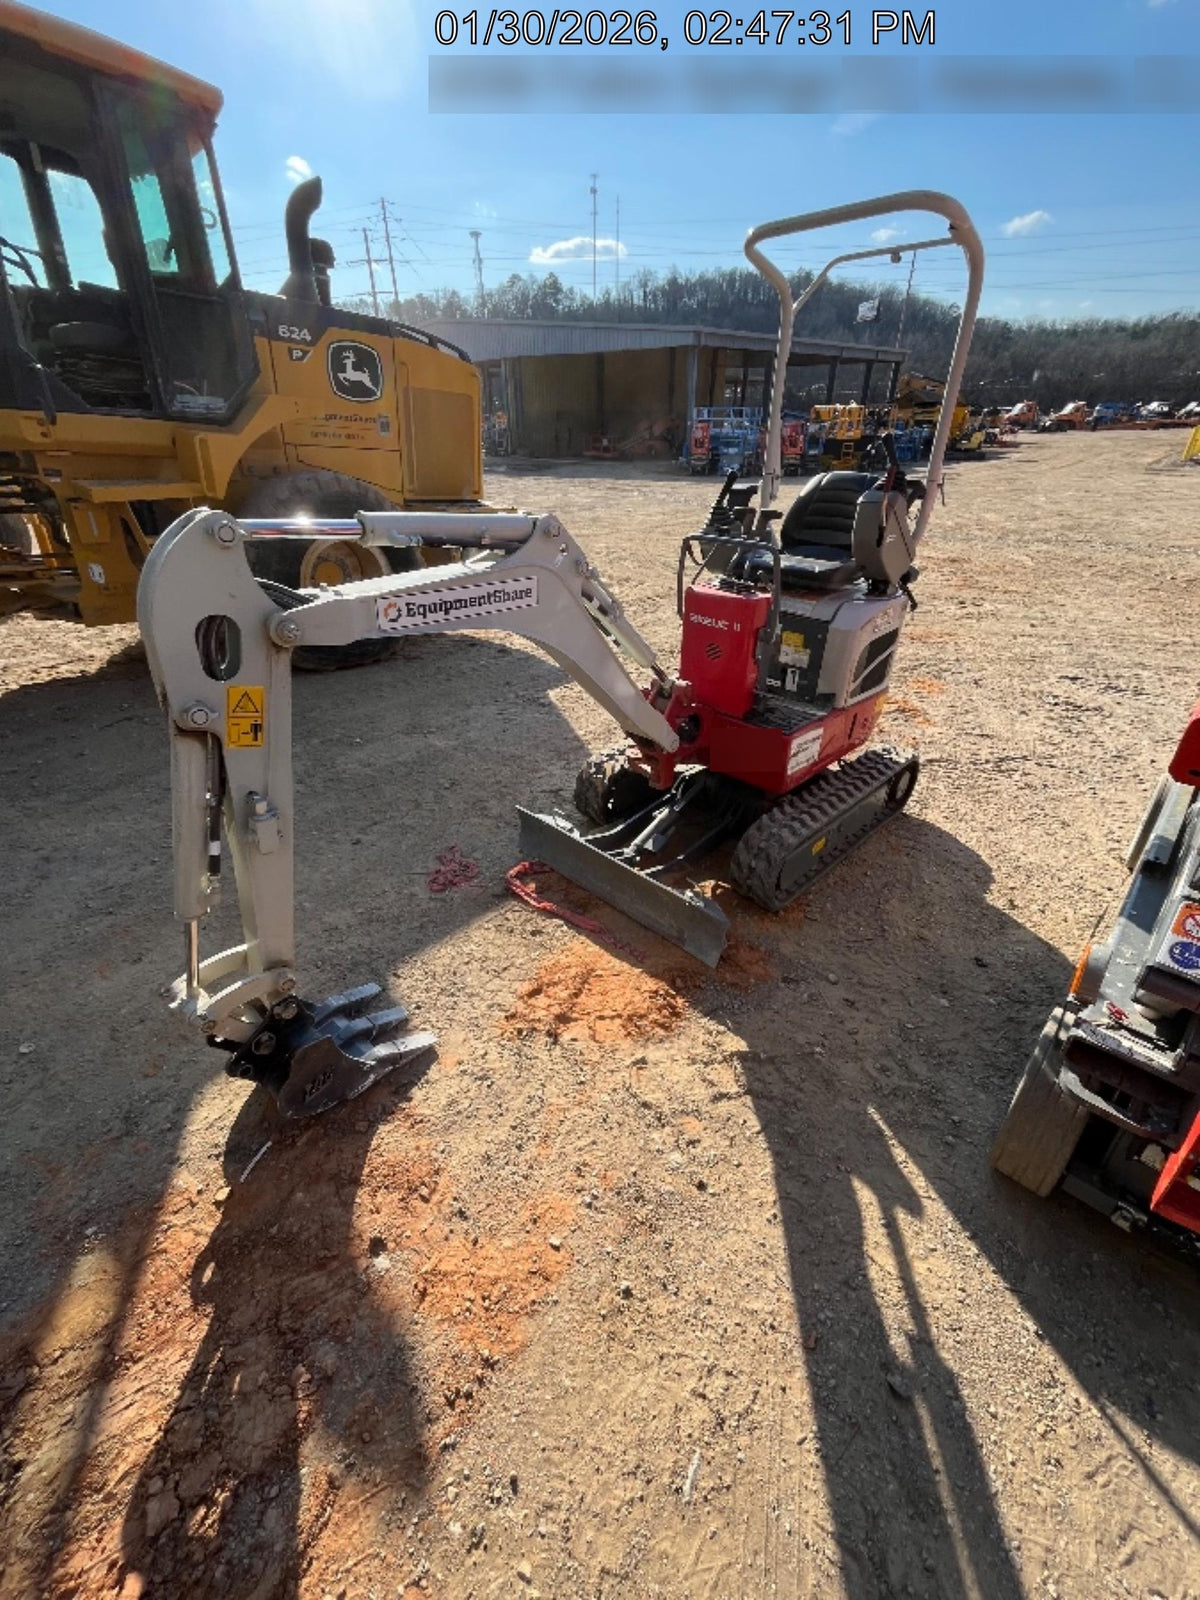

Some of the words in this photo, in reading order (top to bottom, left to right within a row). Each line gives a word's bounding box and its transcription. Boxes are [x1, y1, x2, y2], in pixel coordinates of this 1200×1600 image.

[278, 324, 312, 342] 624
[292, 349, 303, 360] P
[405, 587, 532, 619] EquipmentShare
